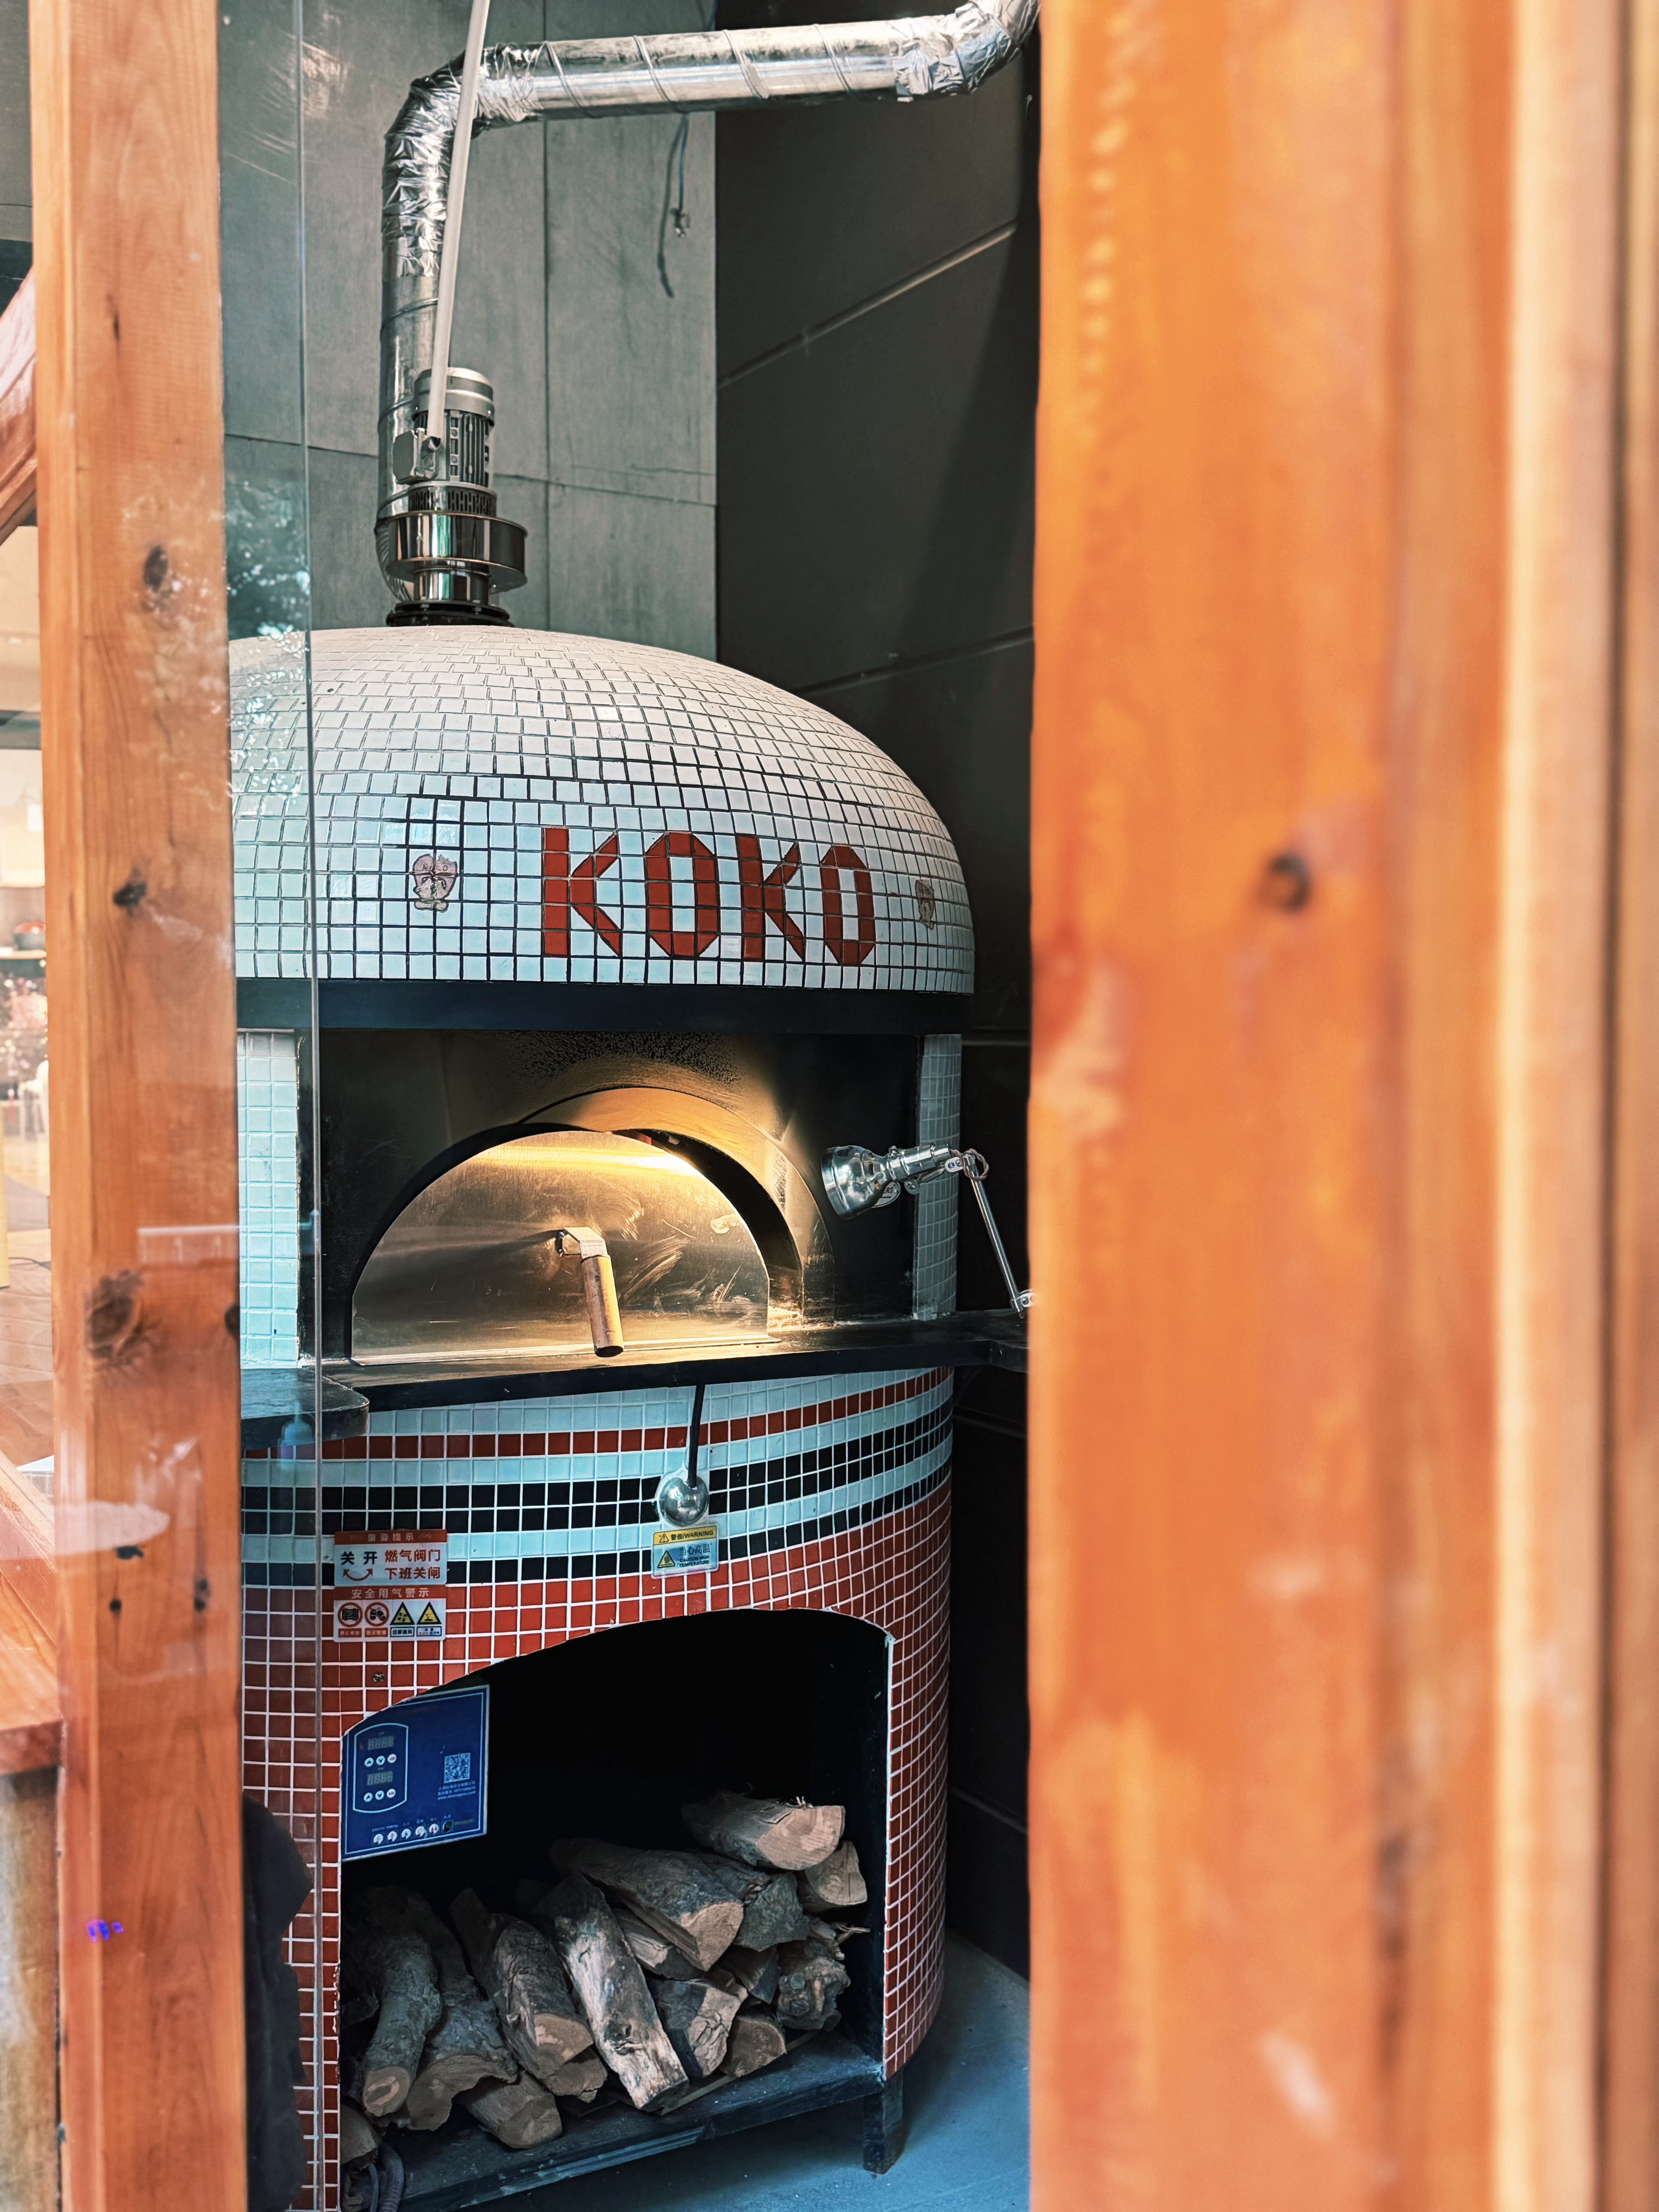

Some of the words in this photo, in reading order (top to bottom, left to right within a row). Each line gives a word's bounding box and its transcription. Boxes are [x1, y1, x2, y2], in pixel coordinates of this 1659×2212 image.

[544, 828, 876, 965] KOKO
[341, 1551, 355, 1565] 关
[363, 1551, 377, 1565] 开
[385, 1549, 441, 1563] 燃气阀门
[385, 1566, 441, 1580] 下班关闸
[351, 1587, 429, 1599] 安全用气警示
